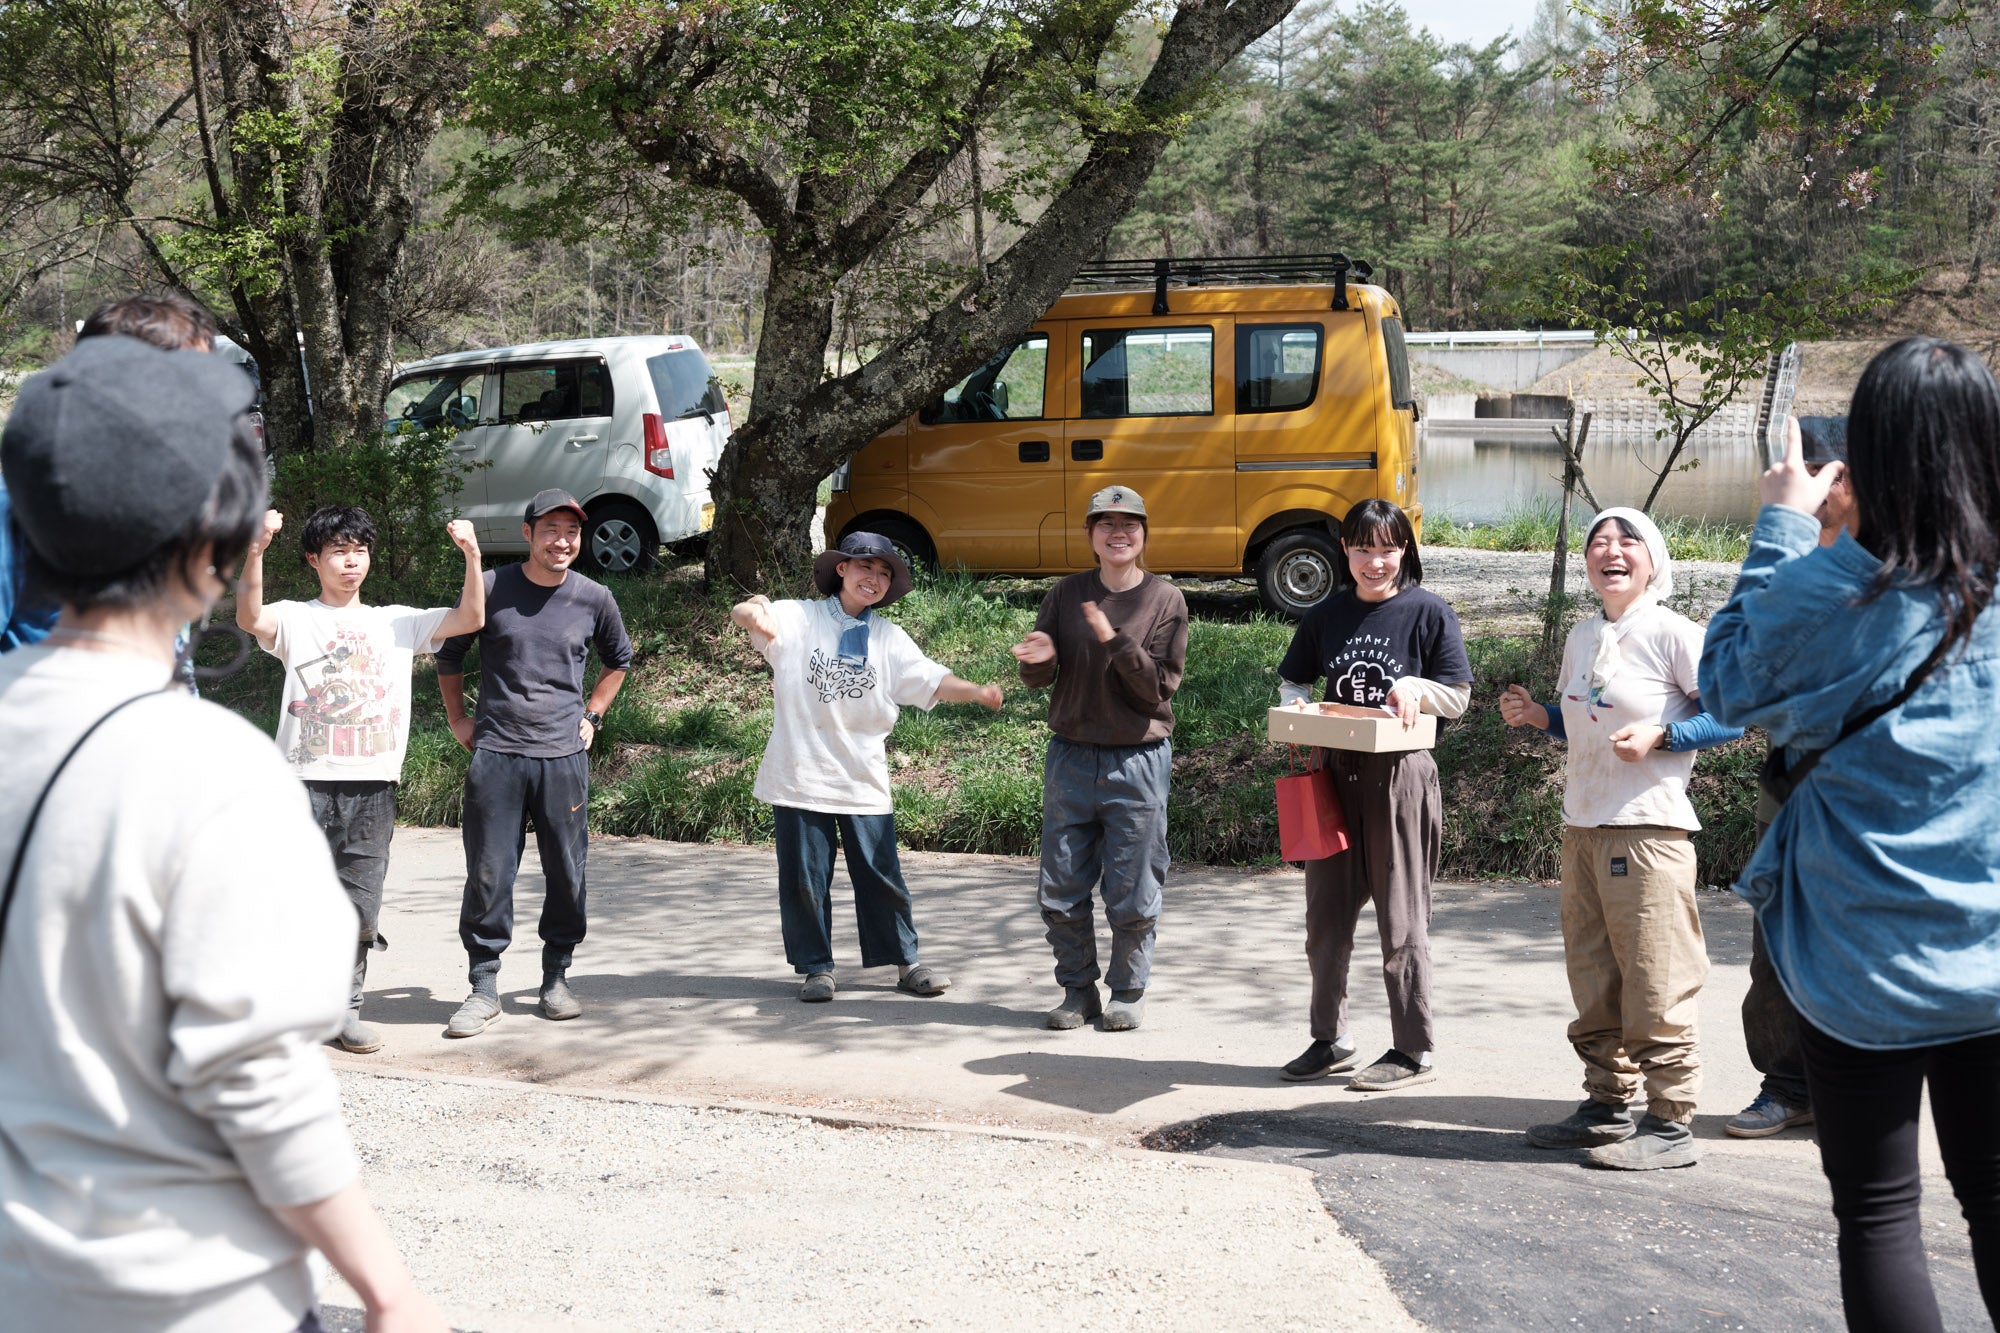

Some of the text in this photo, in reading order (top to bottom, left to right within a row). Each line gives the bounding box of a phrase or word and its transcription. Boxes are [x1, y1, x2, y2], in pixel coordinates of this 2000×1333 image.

[1345, 634, 1390, 646] UMAMI
[1329, 649, 1403, 673] VEGETABLES
[806, 675, 875, 691] JULY 23-27
[818, 688, 863, 703] TOKYO
